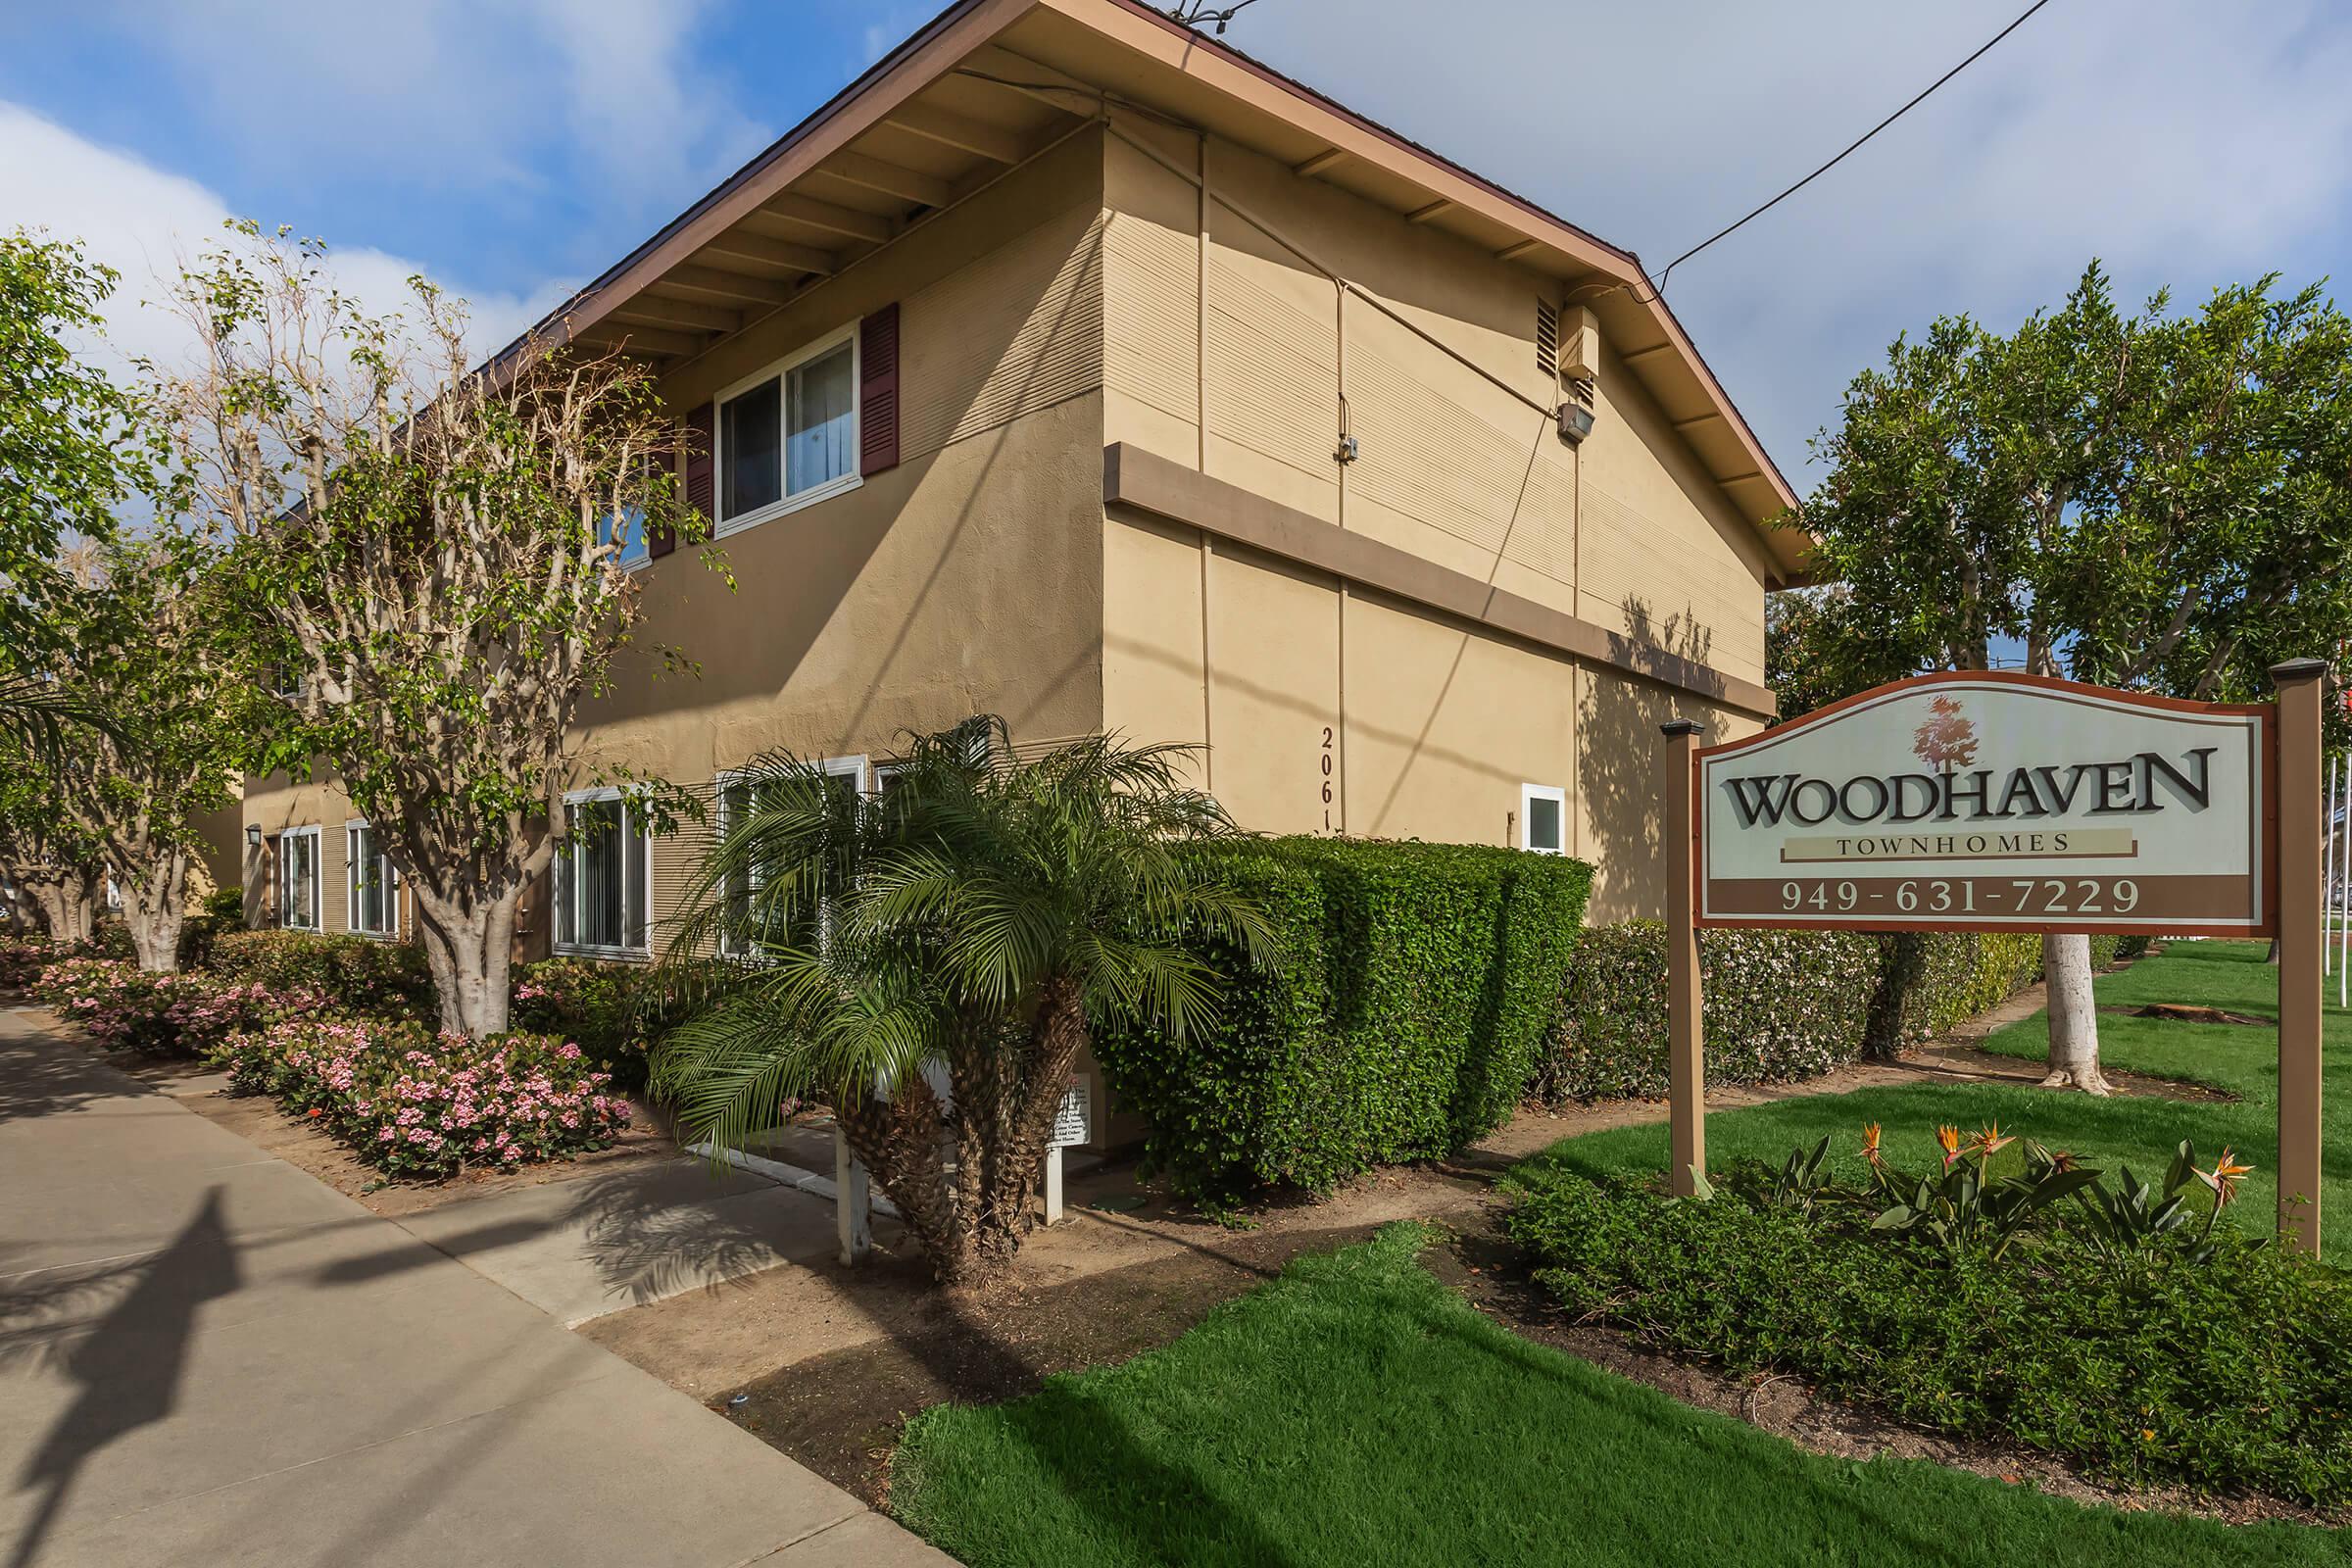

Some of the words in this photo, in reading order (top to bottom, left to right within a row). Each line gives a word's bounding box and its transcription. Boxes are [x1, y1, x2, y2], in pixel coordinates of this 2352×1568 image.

[1321, 727, 1334, 831] 2061
[1723, 748, 2218, 827] WOODHAVEN
[1838, 833, 2069, 856] TOWNHOMES
[1782, 880, 2139, 912] 949-631-7229
